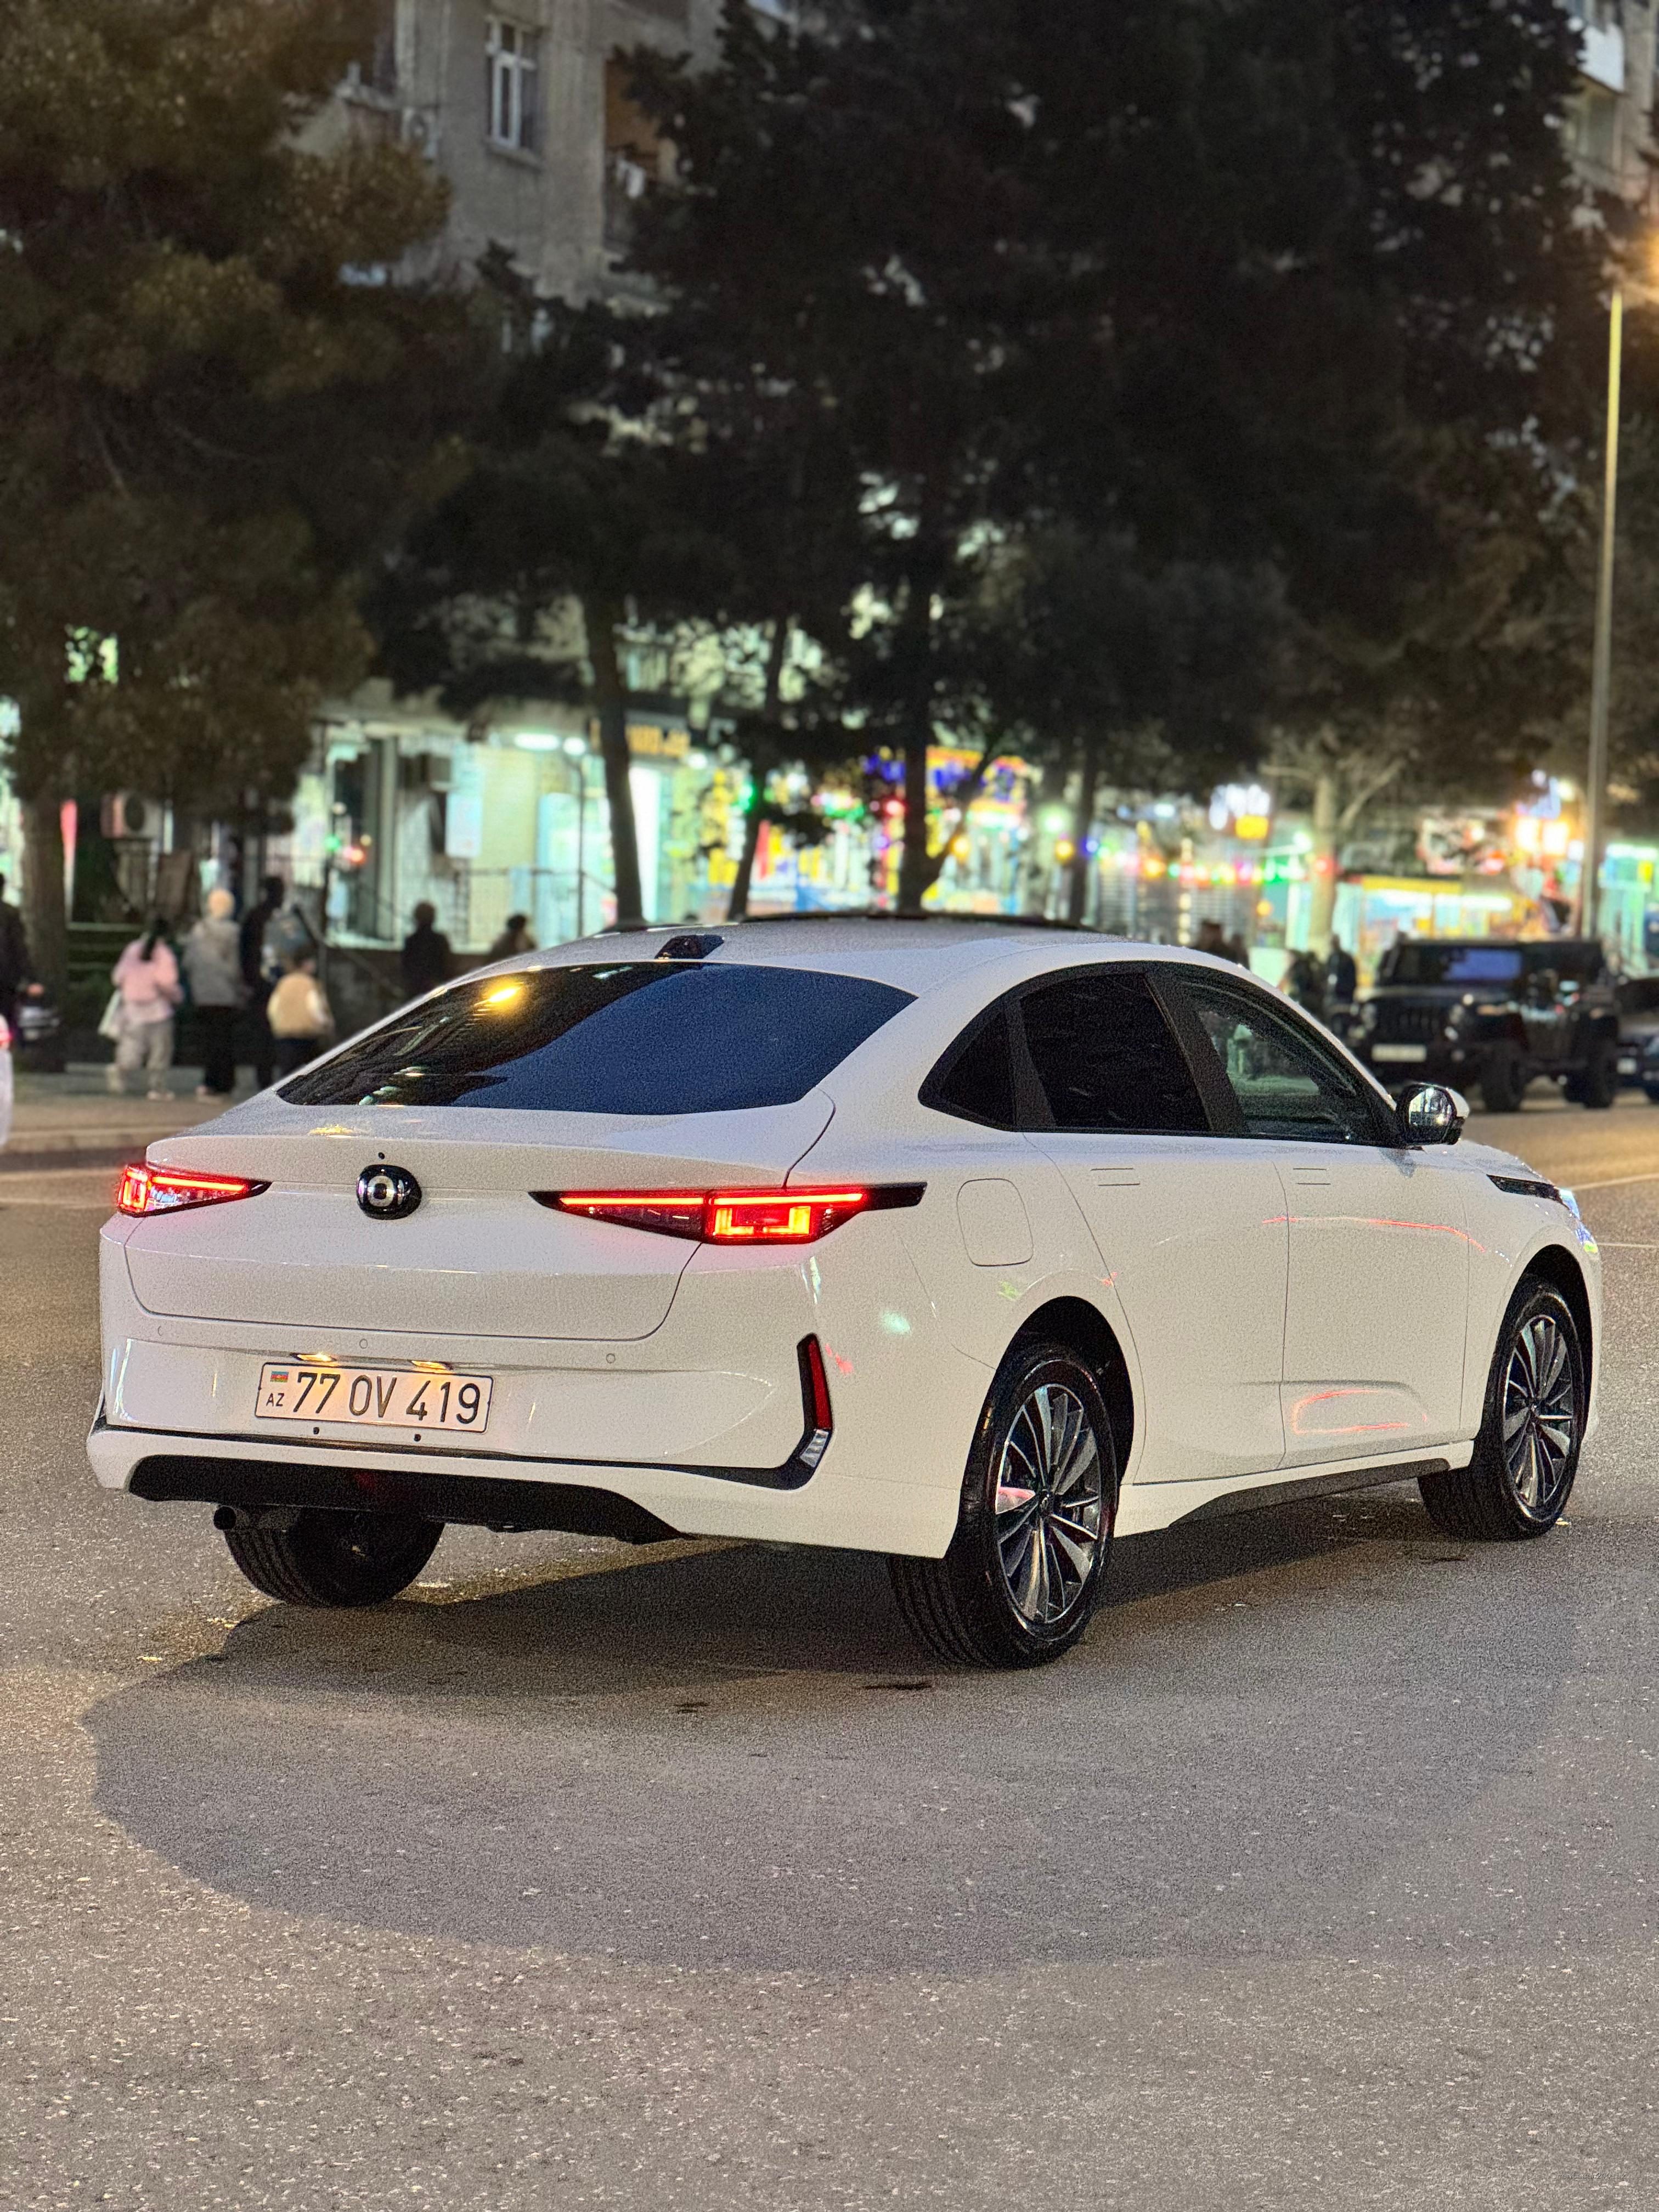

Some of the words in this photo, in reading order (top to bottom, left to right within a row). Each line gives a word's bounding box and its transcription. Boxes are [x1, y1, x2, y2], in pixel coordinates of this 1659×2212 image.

[266, 1392, 285, 1407] AZ
[293, 1372, 341, 1414] 77
[349, 1375, 398, 1418] OV
[405, 1380, 481, 1425] 419
